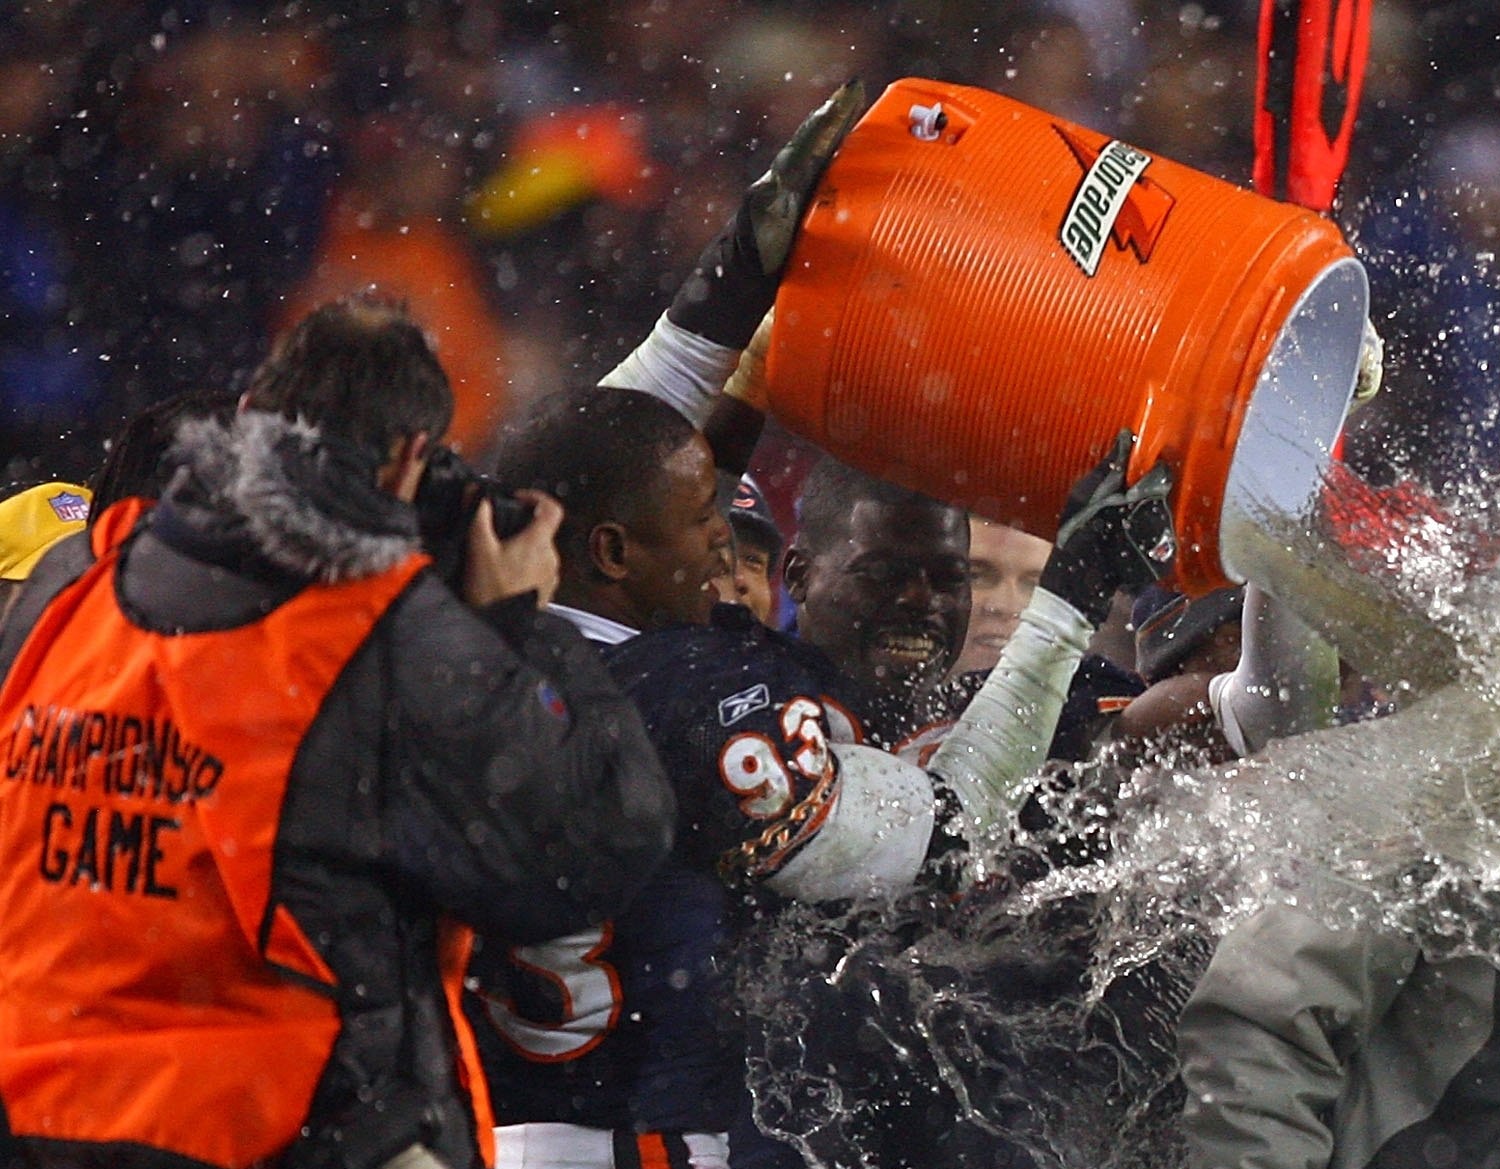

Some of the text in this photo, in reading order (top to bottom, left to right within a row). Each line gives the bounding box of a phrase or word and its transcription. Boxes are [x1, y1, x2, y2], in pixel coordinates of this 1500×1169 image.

[6, 704, 224, 807] CHAMPIONSP
[719, 695, 830, 820] 93
[40, 802, 181, 898] GAME
